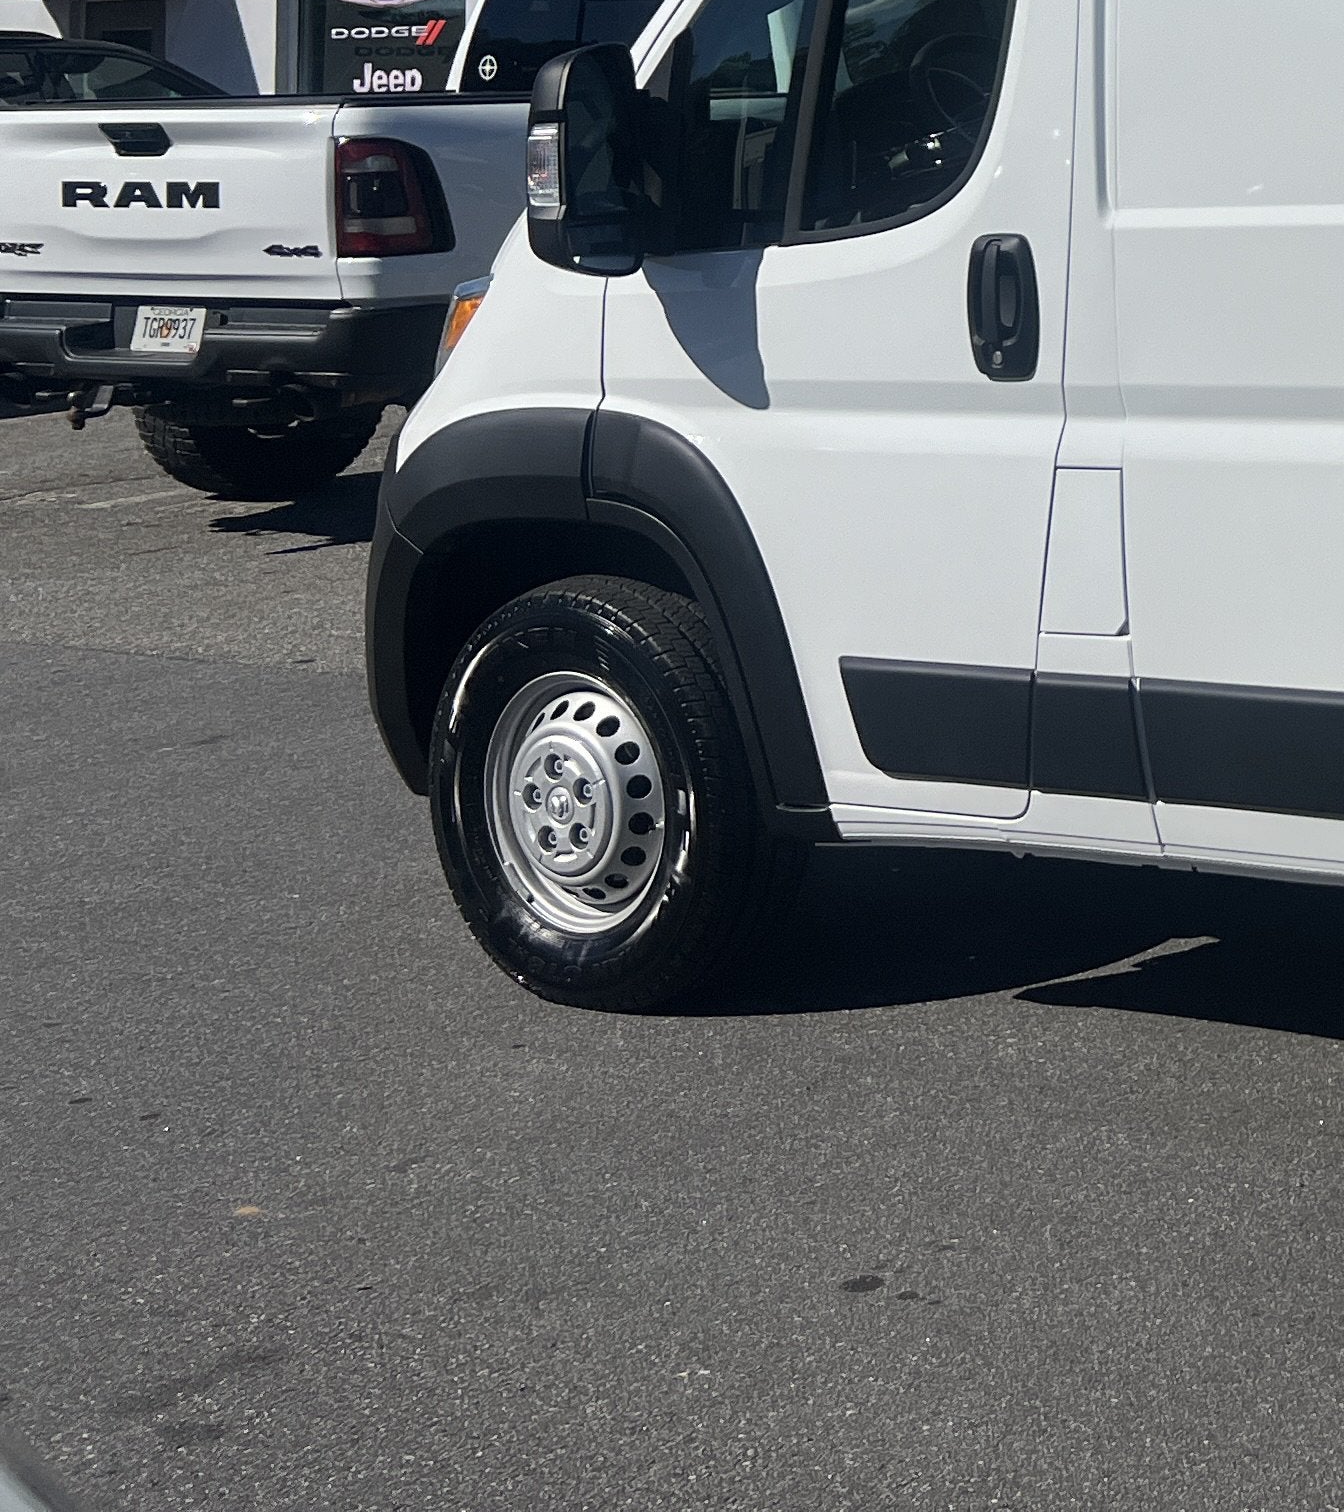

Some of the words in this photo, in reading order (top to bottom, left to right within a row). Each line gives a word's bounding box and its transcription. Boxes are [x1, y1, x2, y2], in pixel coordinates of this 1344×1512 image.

[331, 25, 430, 39] DODGE
[353, 62, 422, 93] Jeep
[61, 181, 220, 209] RAM
